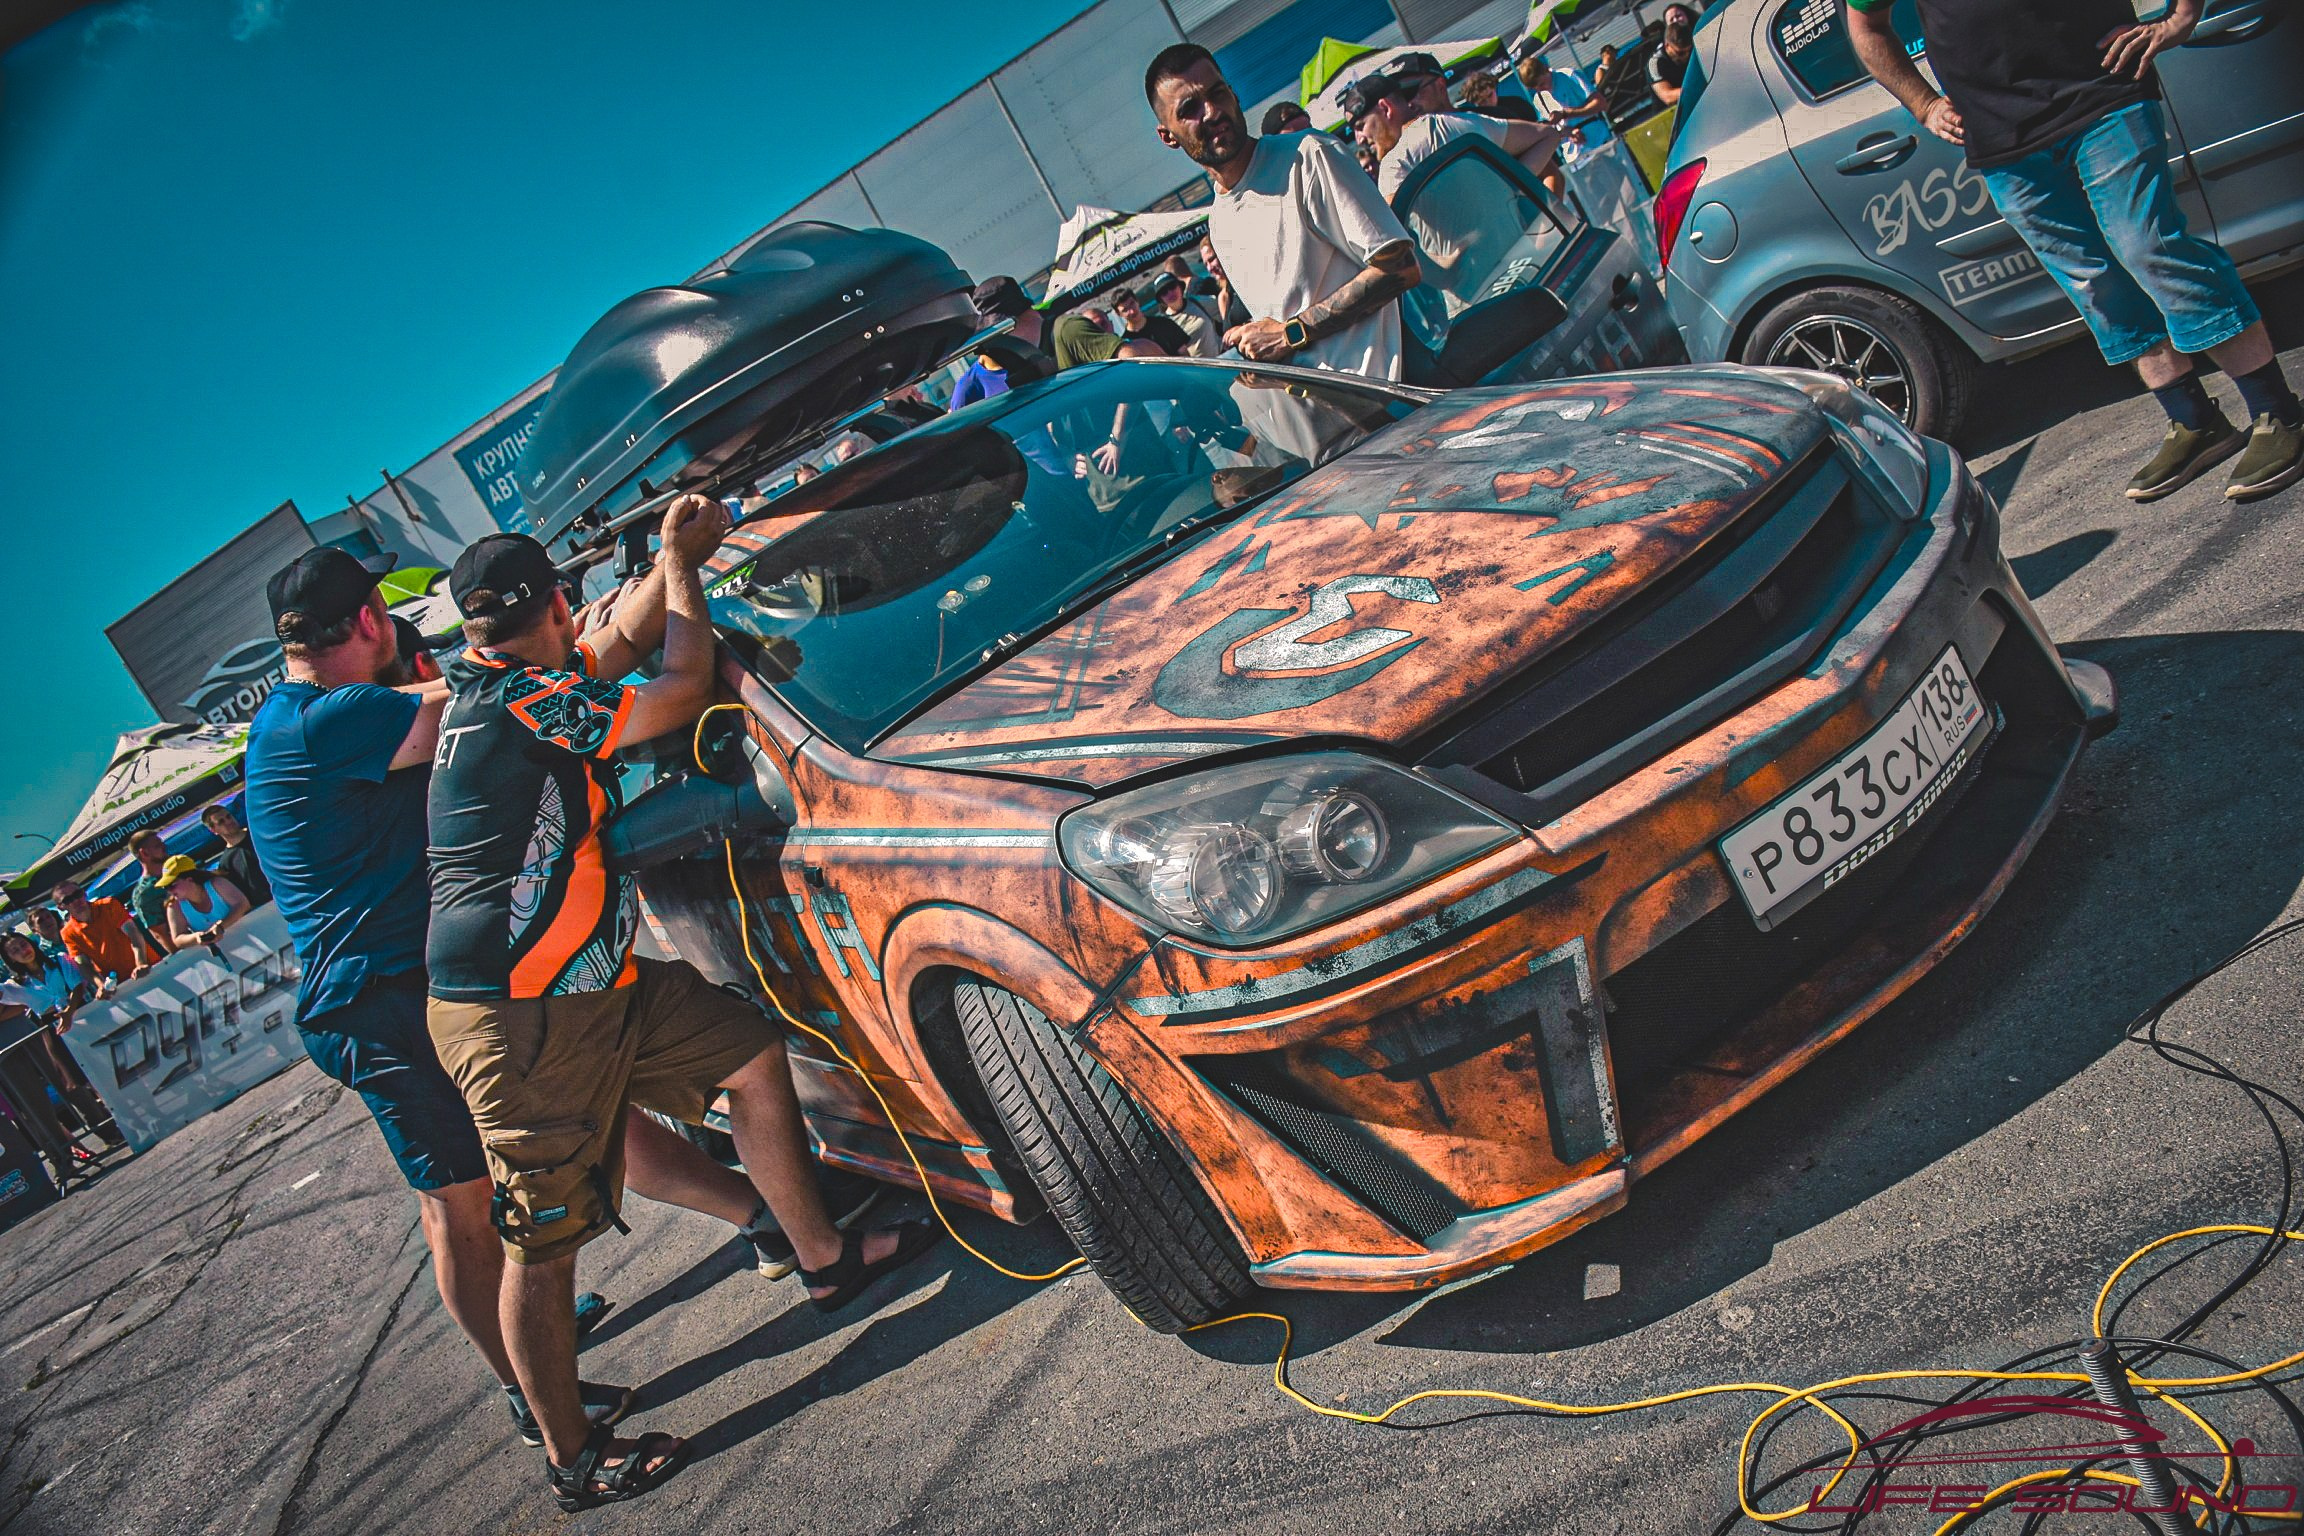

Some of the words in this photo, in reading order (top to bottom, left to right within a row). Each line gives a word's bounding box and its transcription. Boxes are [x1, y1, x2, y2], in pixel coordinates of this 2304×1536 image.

[1071, 223, 1209, 298] http://en.alphardaudio.ru
[1946, 249, 2038, 294] TEAM
[712, 576, 743, 599] 071
[1921, 663, 1965, 732] 138
[1943, 716, 1967, 748] RUS
[66, 794, 186, 866] http://alphard.audio
